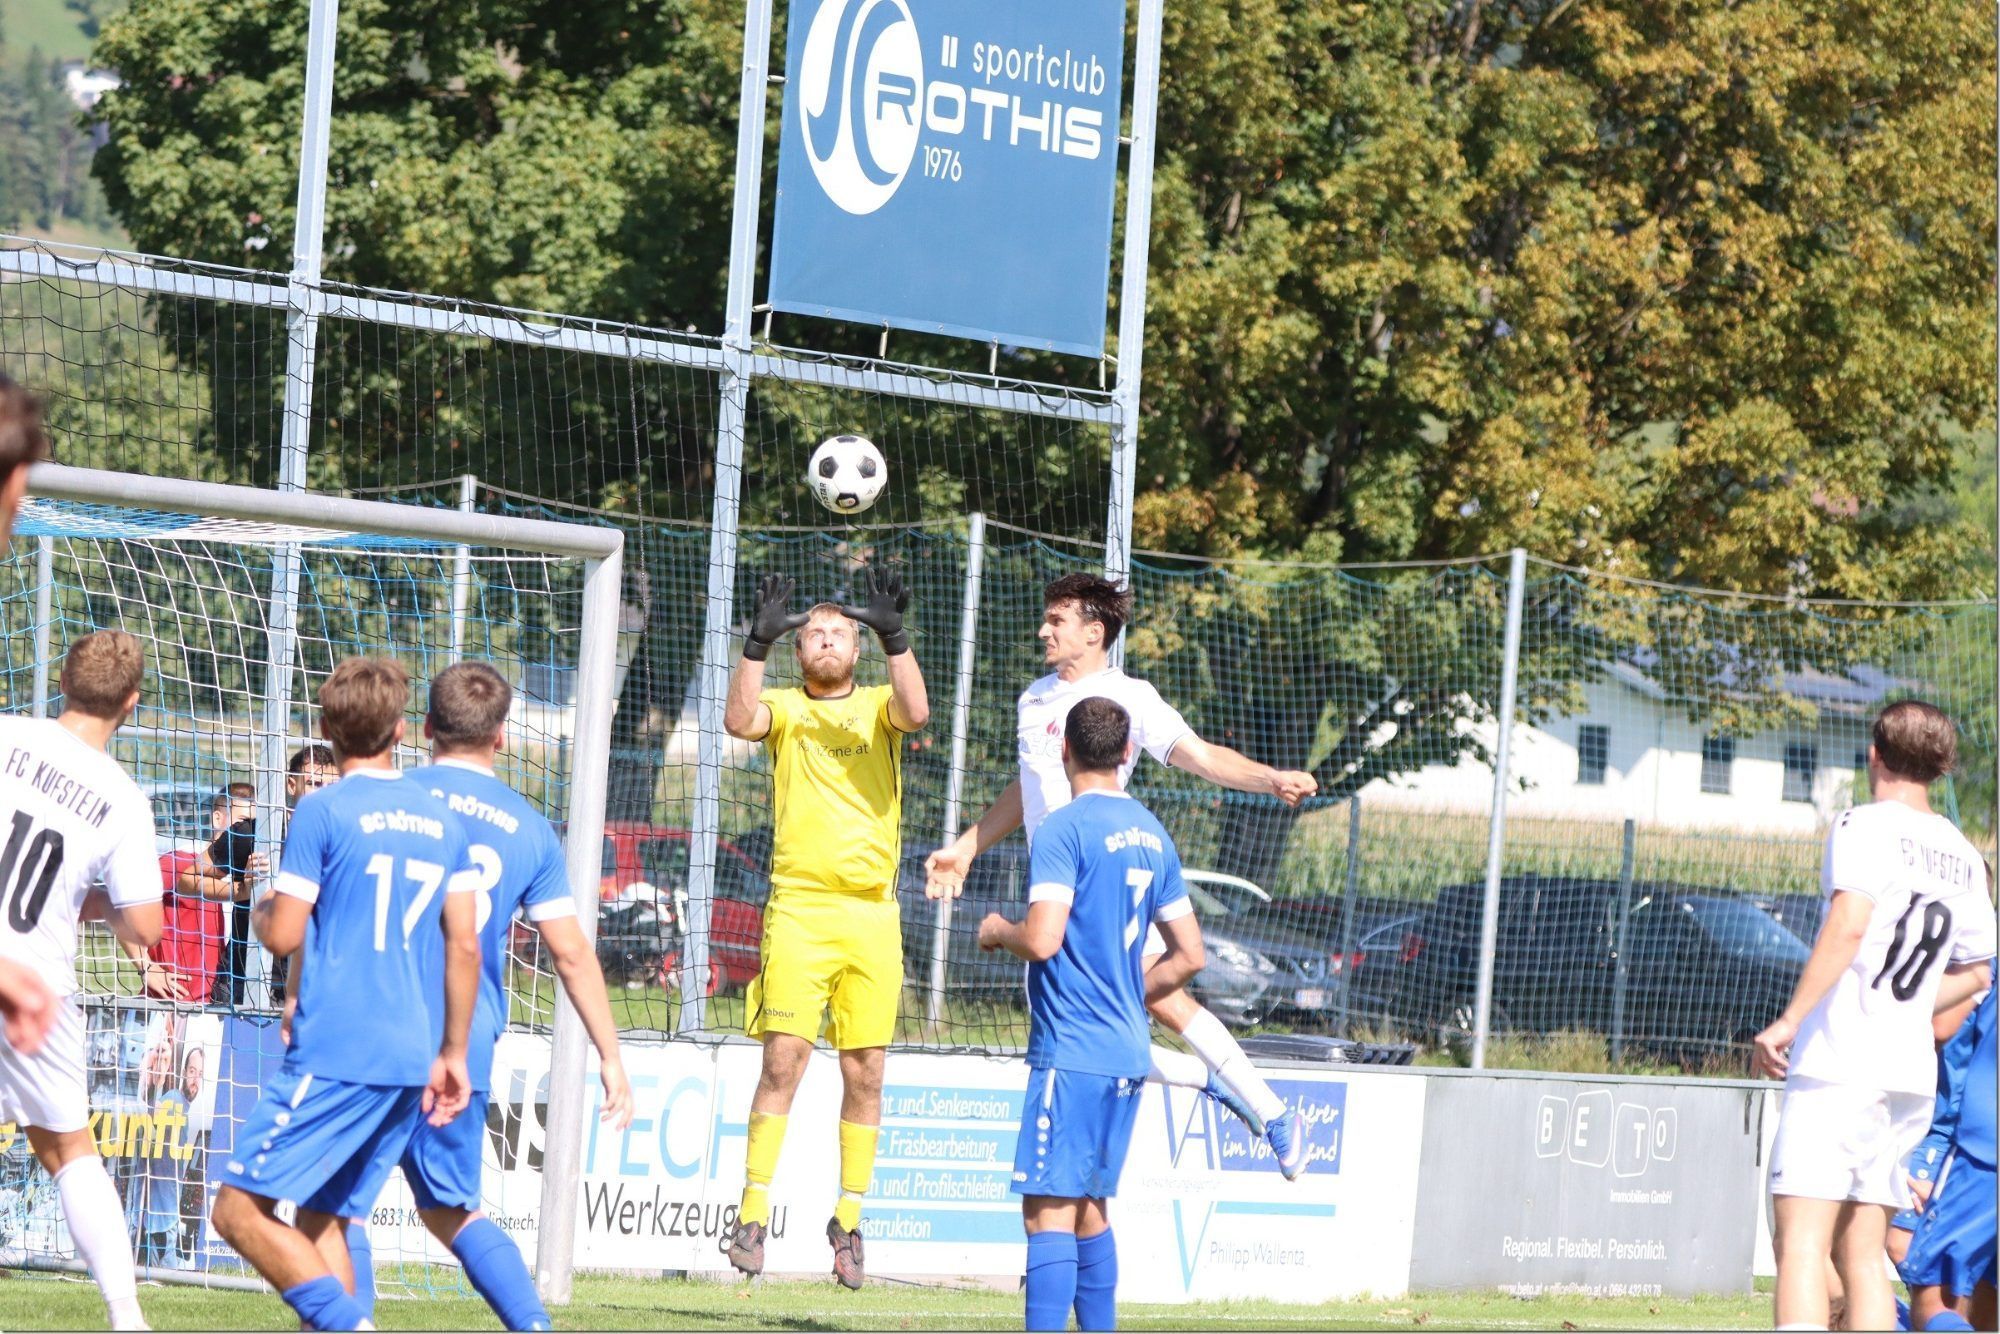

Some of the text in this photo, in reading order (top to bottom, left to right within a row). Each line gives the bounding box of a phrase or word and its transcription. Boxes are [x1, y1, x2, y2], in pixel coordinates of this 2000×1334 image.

[972, 41, 1105, 96] sportclub
[924, 145, 962, 182] 1976
[5, 747, 112, 828] FC KUFSTEIN
[359, 812, 386, 834] SC
[448, 793, 519, 834] RÖTHIS
[1104, 832, 1126, 853] SC
[0, 809, 64, 934] 10
[365, 854, 445, 952] 17
[1124, 867, 1155, 953] 7
[1871, 889, 1953, 1002] 18
[898, 1091, 927, 1116] und
[928, 1091, 1010, 1119] Senkerosion
[889, 1129, 999, 1173] Fräsbearbeitung
[1222, 1131, 1247, 1158] im
[884, 1172, 910, 1198] und
[913, 1172, 1007, 1200] Profilschleifen
[1650, 1190, 1673, 1205] GmbH
[372, 1207, 404, 1226] 6833
[1209, 1241, 1306, 1273] Philipp Wallenta
[1502, 1235, 1668, 1263] Regional. Flexibel. Persönlich.
